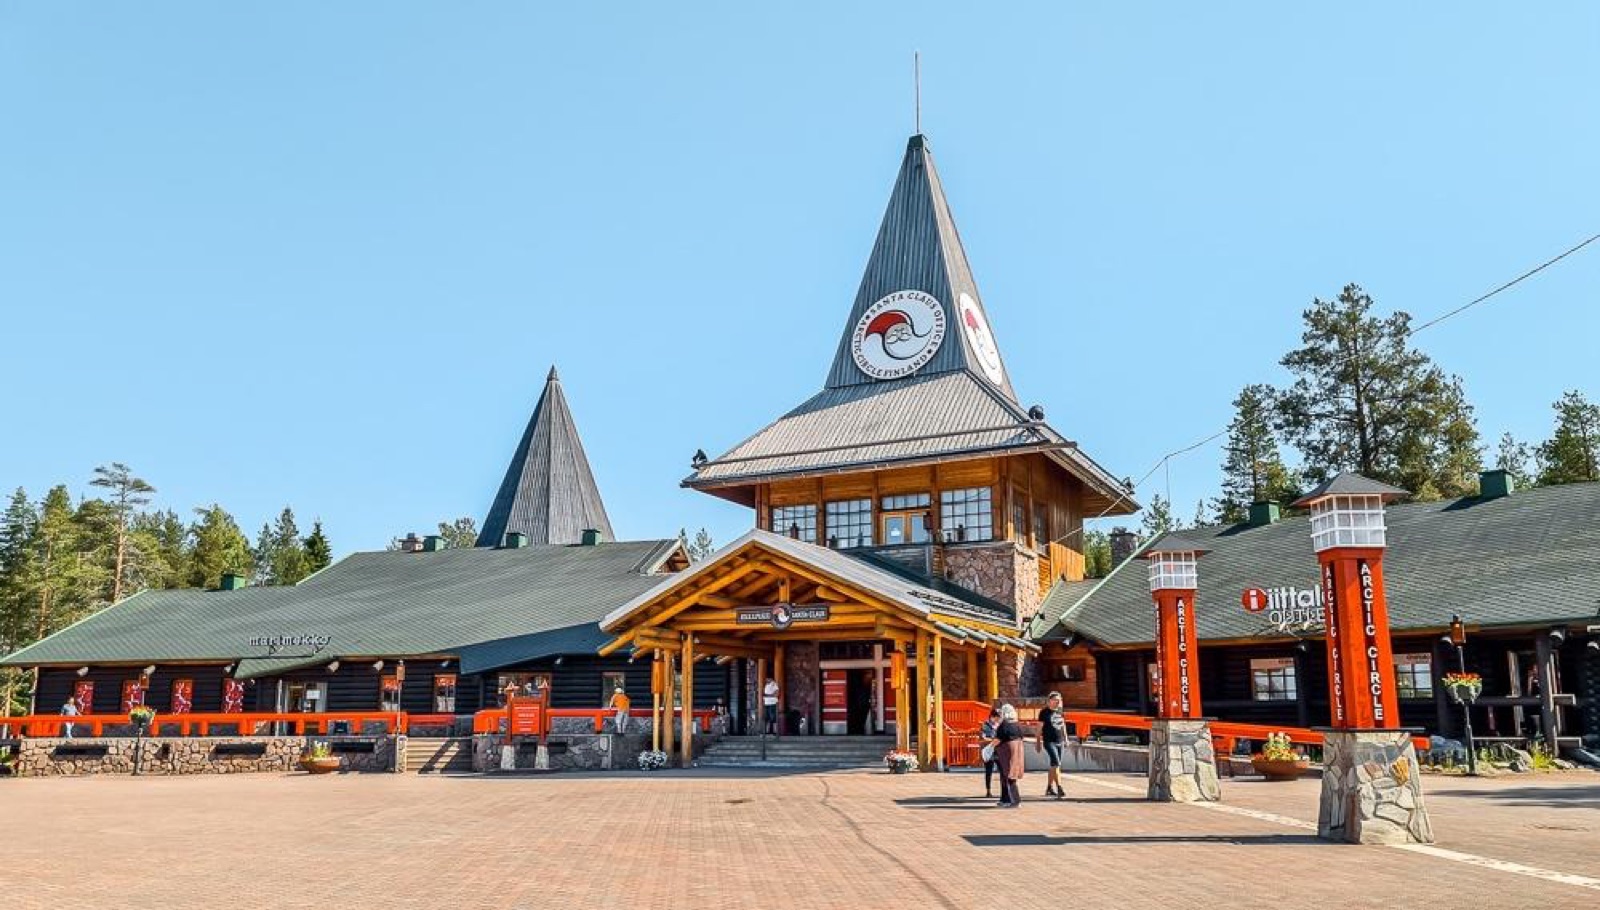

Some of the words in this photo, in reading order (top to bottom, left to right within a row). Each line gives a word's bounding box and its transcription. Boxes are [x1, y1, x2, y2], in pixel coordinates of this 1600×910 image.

[854, 319, 867, 354] ARCTIC
[870, 293, 904, 314] SANTA
[907, 292, 937, 309] CLAUS
[931, 310, 944, 347] OFFICE
[857, 354, 881, 376] CIRCLE
[883, 355, 927, 377] FINLAND
[1267, 584, 1326, 610] iittal
[1269, 607, 1326, 625] OUTLE
[1361, 563, 1376, 636] ARCTIC
[1177, 599, 1187, 652] ARCTIC
[1325, 565, 1337, 637] ARCTIC
[1332, 647, 1343, 720] CIRCLE
[1180, 658, 1190, 713] CIRCLE
[1367, 647, 1384, 720] CIRCLE
